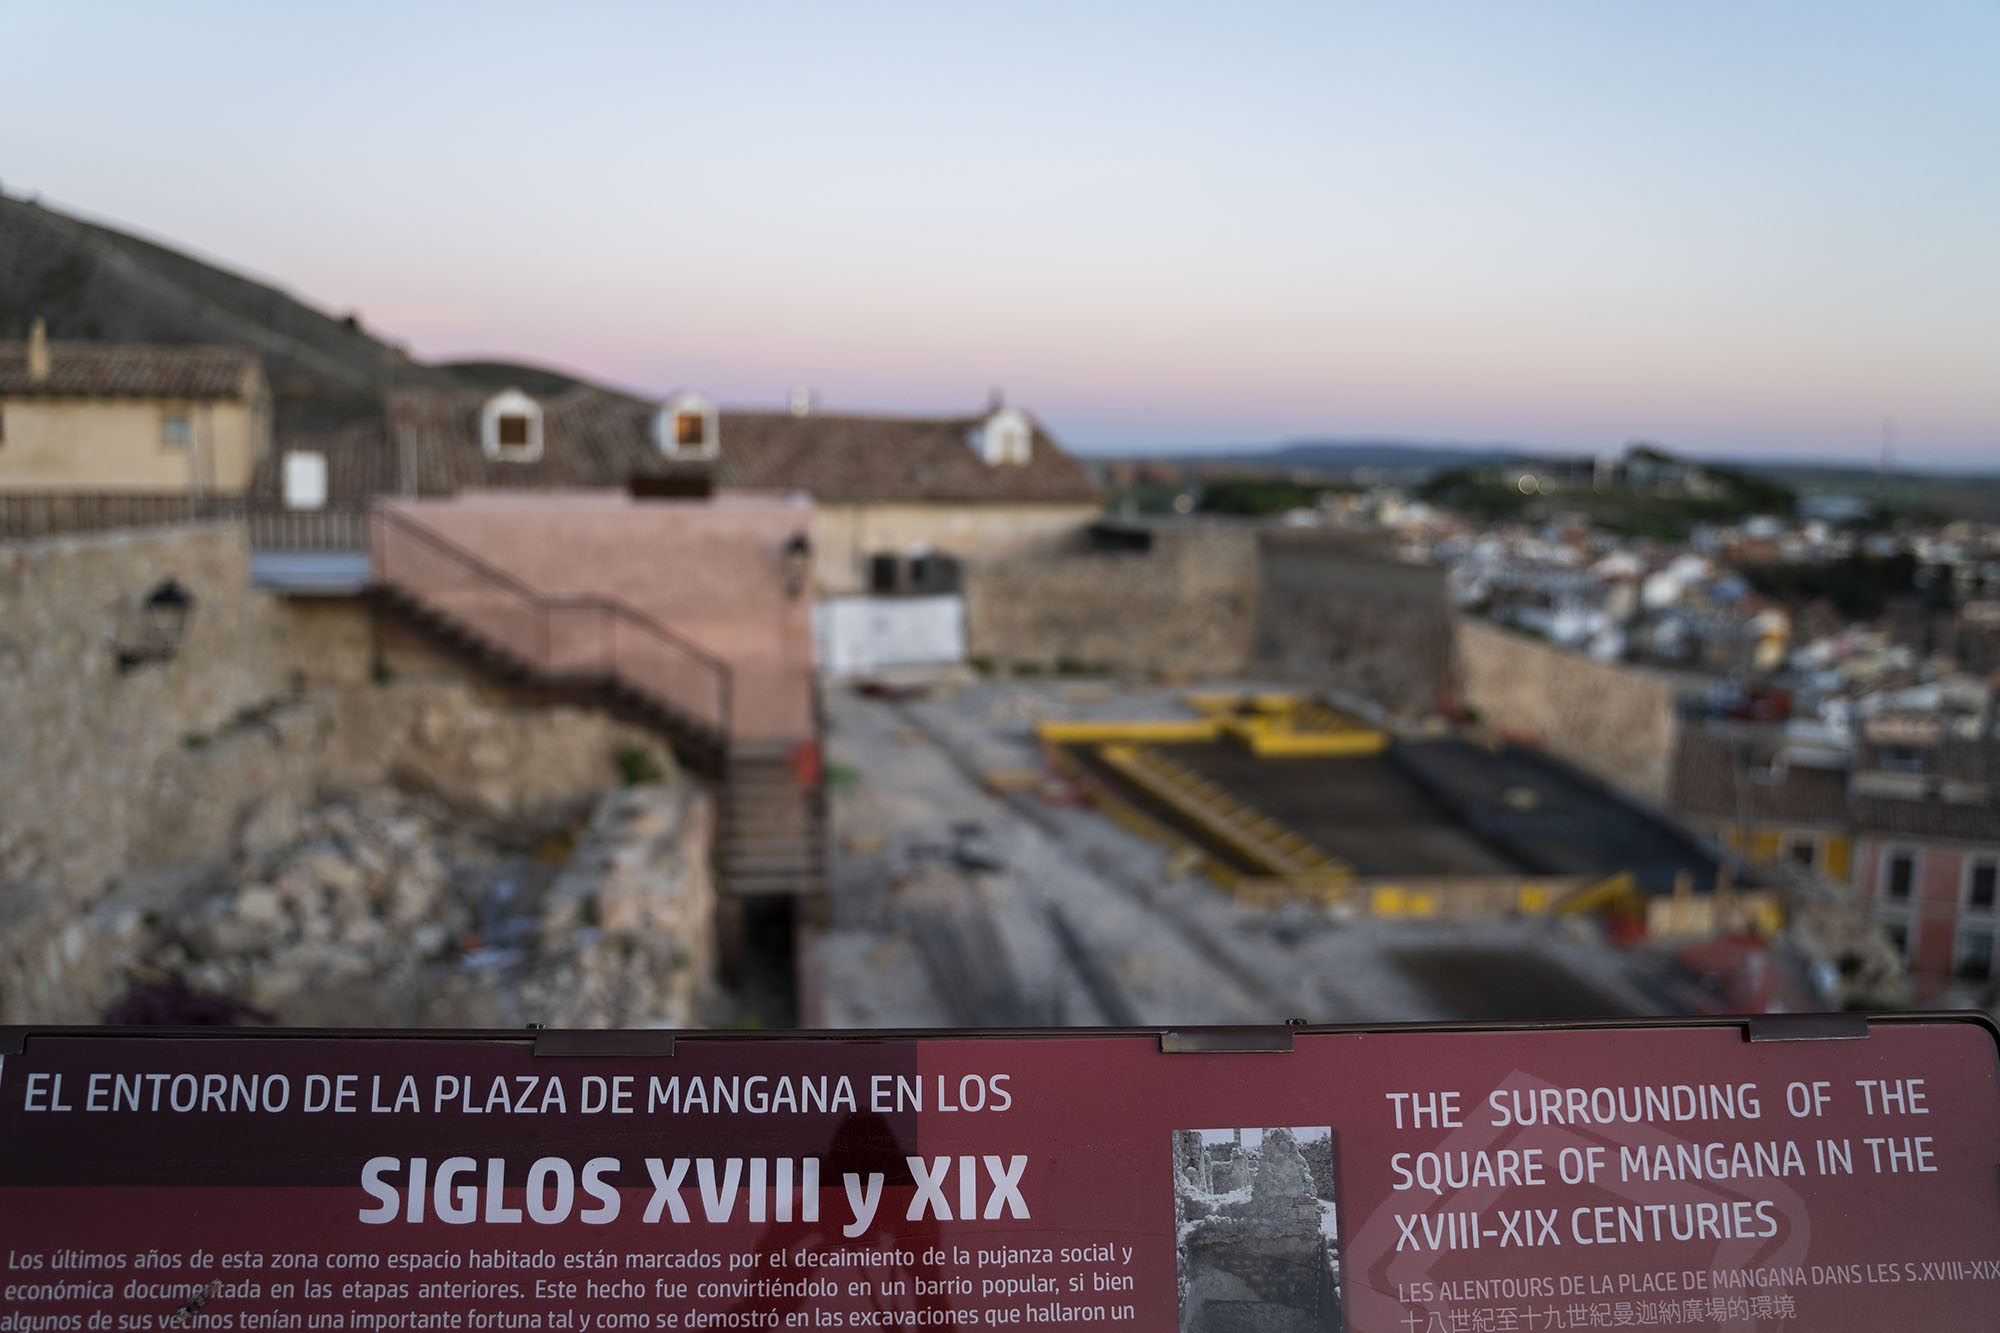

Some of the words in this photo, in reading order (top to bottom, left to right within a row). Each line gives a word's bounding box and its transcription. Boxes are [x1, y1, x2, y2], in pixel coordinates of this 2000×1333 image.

[24, 1073, 72, 1111] EL
[86, 1074, 290, 1112] ENTORNO
[304, 1074, 358, 1112] DE
[371, 1075, 420, 1113] LA
[435, 1075, 566, 1113] PLAZA
[581, 1076, 634, 1113] DE
[648, 1076, 857, 1113] MANGANA
[871, 1075, 922, 1112] EN
[938, 1074, 1011, 1112] LOS
[1386, 1092, 1463, 1129] THE
[1489, 1083, 1760, 1126] SURROUNDING
[1787, 1081, 1831, 1118] OF
[1856, 1079, 1929, 1115] THE
[1391, 1149, 1545, 1195] SQUARE
[1559, 1147, 1605, 1184] OF
[1621, 1141, 1806, 1182] MANGANA
[1816, 1139, 1853, 1175] IN
[1863, 1137, 1938, 1173] THE
[359, 1156, 621, 1224] SIGLOS
[643, 1157, 819, 1223] XVIII
[843, 1173, 884, 1238] y
[906, 1155, 1031, 1221] XIX
[1394, 1209, 1560, 1251] XVIII-XIX
[1572, 1200, 1777, 1244] CENTURIES
[9, 1250, 44, 1270] Los
[51, 1249, 127, 1269] últimos
[134, 1249, 182, 1268] años
[190, 1249, 214, 1269] de
[222, 1251, 263, 1268] esta
[270, 1254, 318, 1268] zona
[326, 1254, 379, 1268] como
[387, 1250, 461, 1272] espacio
[469, 1249, 556, 1268] habitado
[564, 1249, 617, 1268] están
[626, 1249, 721, 1268] marcados
[729, 1253, 762, 1272] por
[770, 1248, 787, 1267] el
[795, 1247, 914, 1267] decaimiento
[922, 1246, 945, 1265] de
[954, 1246, 970, 1264] la
[977, 1245, 1053, 1268] pujanza
[1060, 1242, 1115, 1262] social
[1122, 1247, 1132, 1265] y
[5, 1280, 114, 1301] económica
[271, 1284, 294, 1299] en
[305, 1279, 332, 1299] las
[342, 1281, 409, 1303] etapas
[418, 1280, 524, 1299] anteriores.
[536, 1280, 577, 1299] Este
[587, 1279, 645, 1299] hecho
[655, 1278, 687, 1298] fue
[697, 1277, 838, 1298] convirtiéndolo
[848, 1282, 871, 1296] en
[881, 1281, 905, 1296] un
[915, 1276, 972, 1295] barrio
[982, 1273, 1059, 1298] popular,
[1069, 1273, 1083, 1292] si
[1094, 1272, 1133, 1291] bien
[1399, 1282, 1433, 1302] LES
[1440, 1277, 1554, 1301] ALENTOURS
[1560, 1276, 1585, 1295] DE
[1590, 1275, 1614, 1294] LA
[1619, 1272, 1678, 1293] PLACE
[1683, 1271, 1707, 1290] DE
[1713, 1267, 1807, 1288] MANGANA
[1811, 1264, 1862, 1285] DANS
[1867, 1263, 1900, 1283] LES
[1905, 1260, 2000, 1281] S.XVIII-XIX
[0, 1311, 82, 1333] algunos
[88, 1310, 112, 1330] de
[118, 1314, 152, 1330] sus
[240, 1309, 302, 1329] tenían
[308, 1314, 344, 1329] una
[350, 1309, 462, 1333] importante
[468, 1309, 541, 1329] fortuna
[548, 1309, 574, 1328] tal
[579, 1314, 591, 1332] y
[597, 1314, 650, 1328] como
[656, 1313, 678, 1328] se
[684, 1308, 779, 1328] demostró
[786, 1312, 809, 1327] en
[816, 1307, 843, 1327] las
[849, 1306, 979, 1326] excavaciones
[985, 1308, 1020, 1327] que
[1027, 1302, 1105, 1322] hallaron
[1111, 1305, 1134, 1320] un
